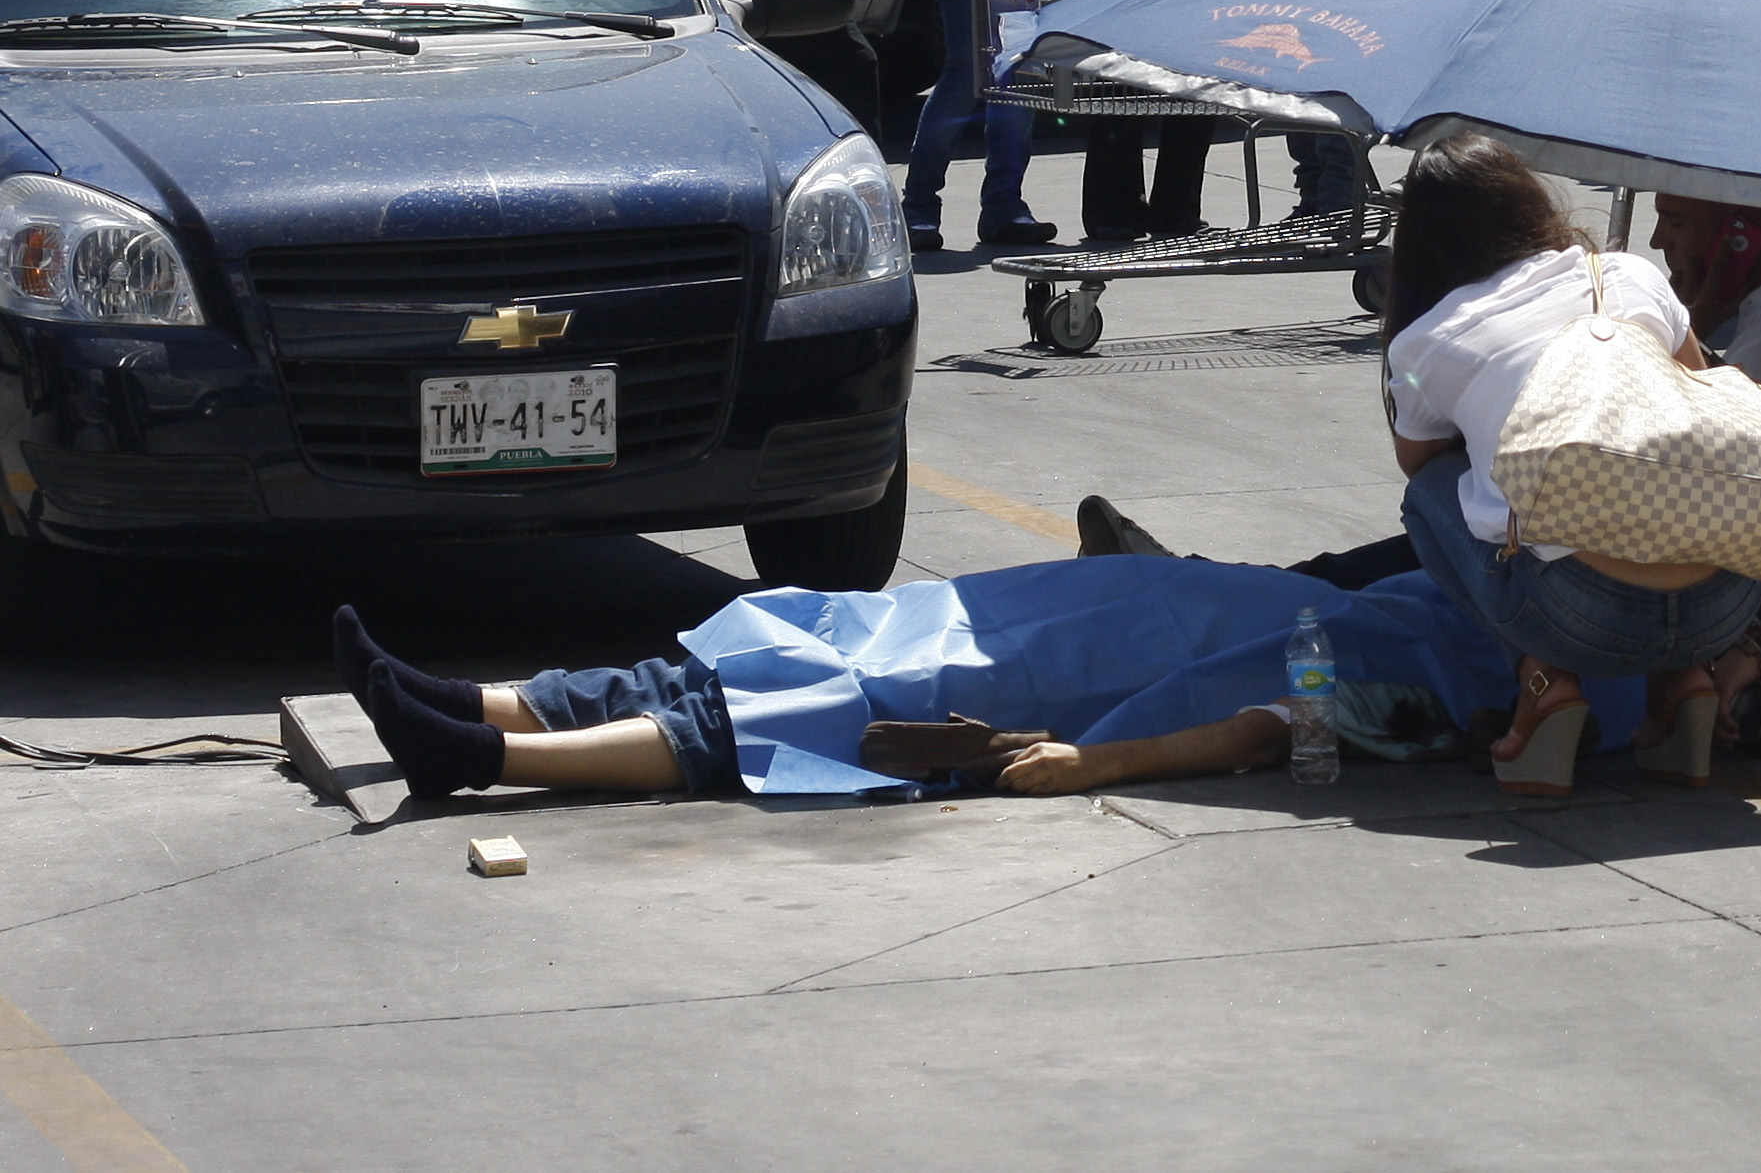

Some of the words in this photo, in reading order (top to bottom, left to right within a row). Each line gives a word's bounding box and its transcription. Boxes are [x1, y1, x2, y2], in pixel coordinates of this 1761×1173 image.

[1209, 3, 1312, 22] TOMMY
[1308, 10, 1385, 58] BAHAMA
[430, 398, 608, 446] TWV-41-54
[500, 449, 544, 460] PUEBLA
